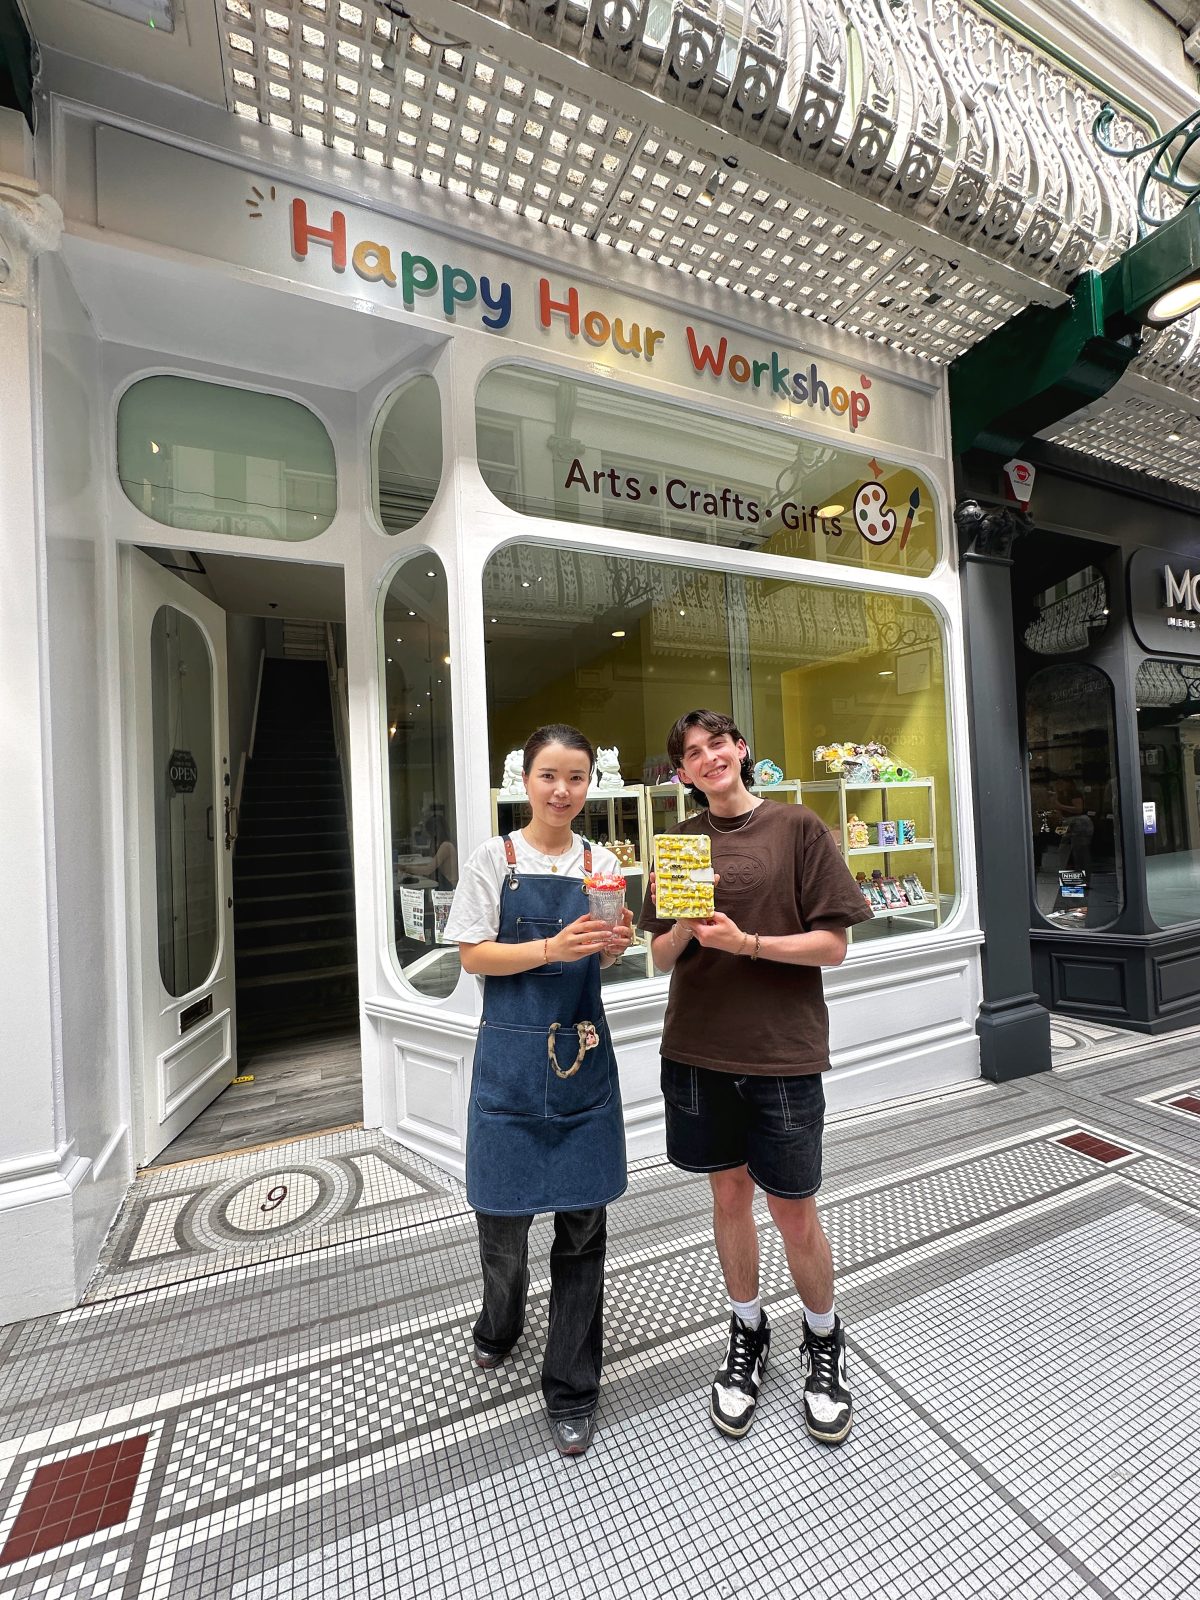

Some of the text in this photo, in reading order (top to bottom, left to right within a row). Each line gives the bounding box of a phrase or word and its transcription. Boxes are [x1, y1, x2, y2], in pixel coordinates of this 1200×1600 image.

[291, 197, 870, 430] Happy Hour Workshop
[564, 458, 843, 537] Arts Crafts Gifts
[1167, 617, 1196, 629] MENS
[170, 766, 197, 780] OPEN
[260, 1185, 288, 1211] 9
